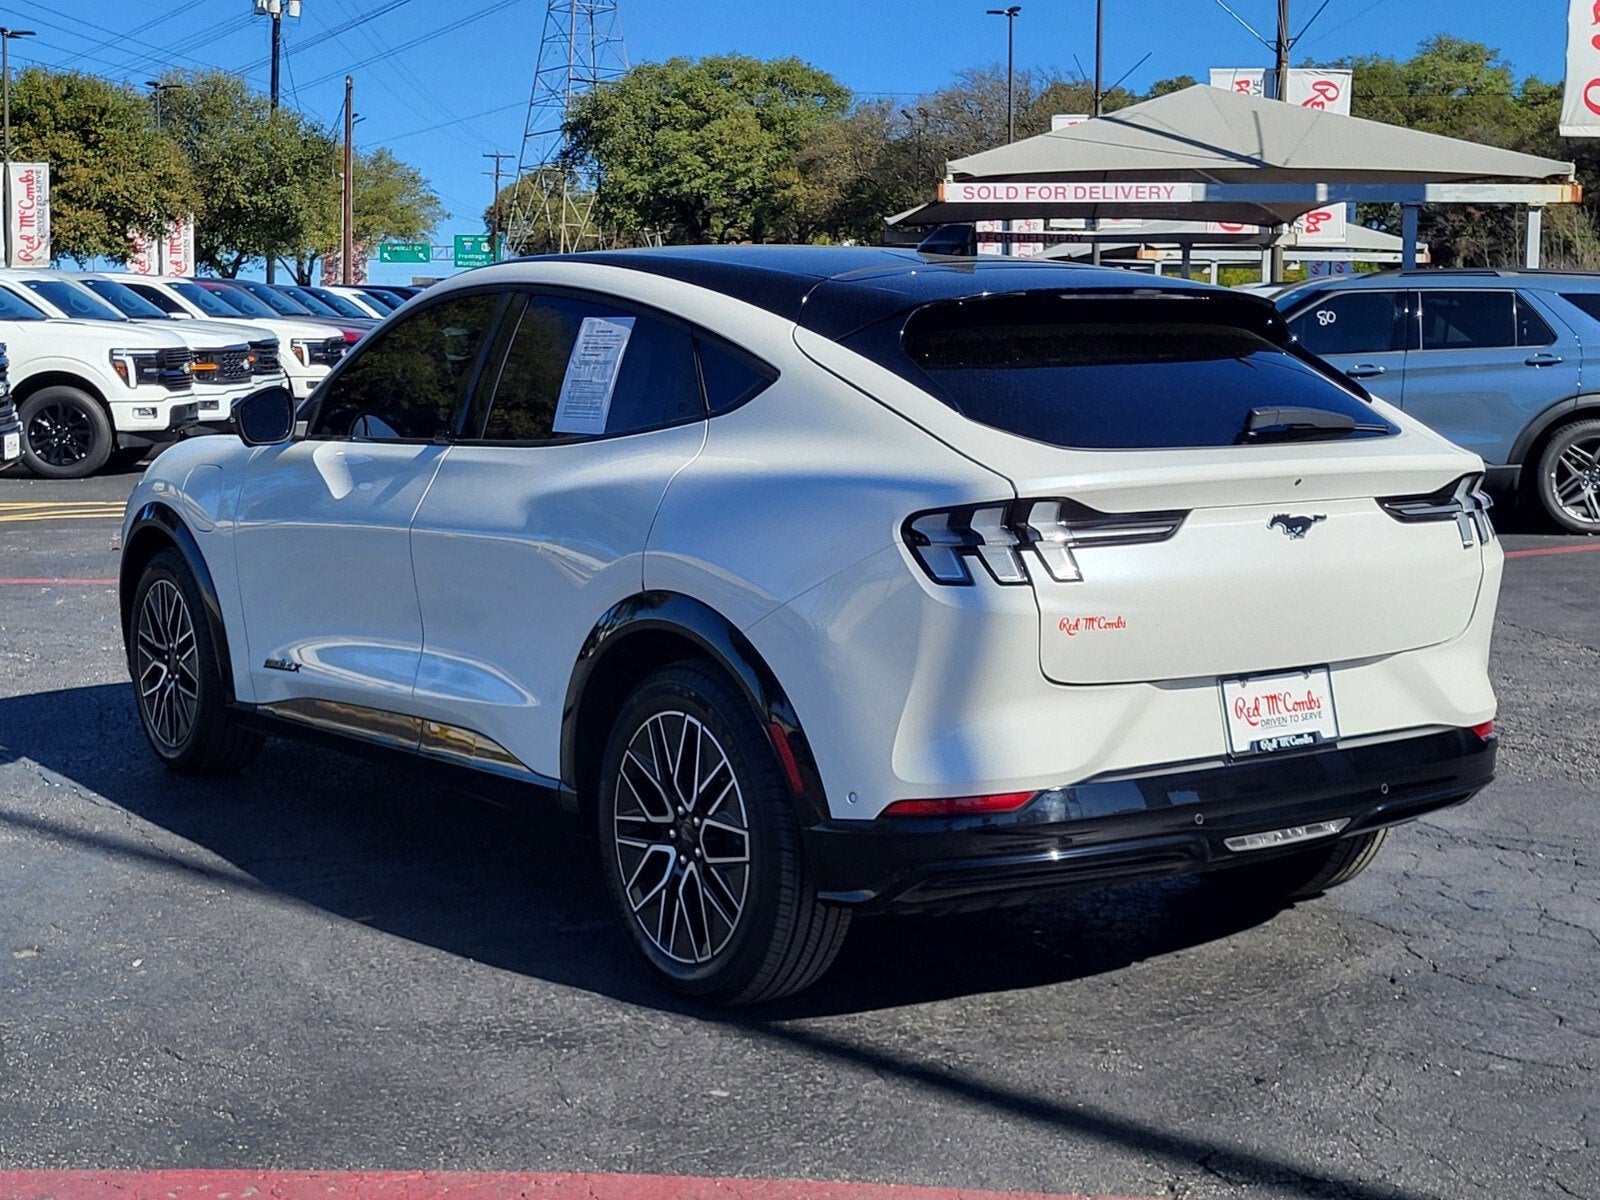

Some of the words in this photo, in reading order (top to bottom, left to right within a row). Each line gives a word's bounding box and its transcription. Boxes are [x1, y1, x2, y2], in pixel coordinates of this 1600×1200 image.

[1302, 80, 1340, 110] Re
[18, 169, 35, 232] McCombs
[36, 195, 42, 206] TO
[963, 185, 1019, 200] SOLD
[1025, 185, 1067, 200] FOR
[1073, 185, 1176, 200] DELIVERY
[1016, 233, 1084, 243] DELIVERY
[17, 235, 42, 262] Red
[1316, 310, 1337, 326] 80
[1059, 617, 1080, 636] Red
[1082, 615, 1126, 630] McCombs
[1234, 696, 1261, 726] Red
[1261, 690, 1321, 716] McCombs
[1261, 716, 1288, 728] DRIVEN
[1289, 715, 1300, 723] TO
[1301, 711, 1322, 721] SERVE
[1260, 739, 1278, 752] Red
[1277, 734, 1314, 748] McCombs
